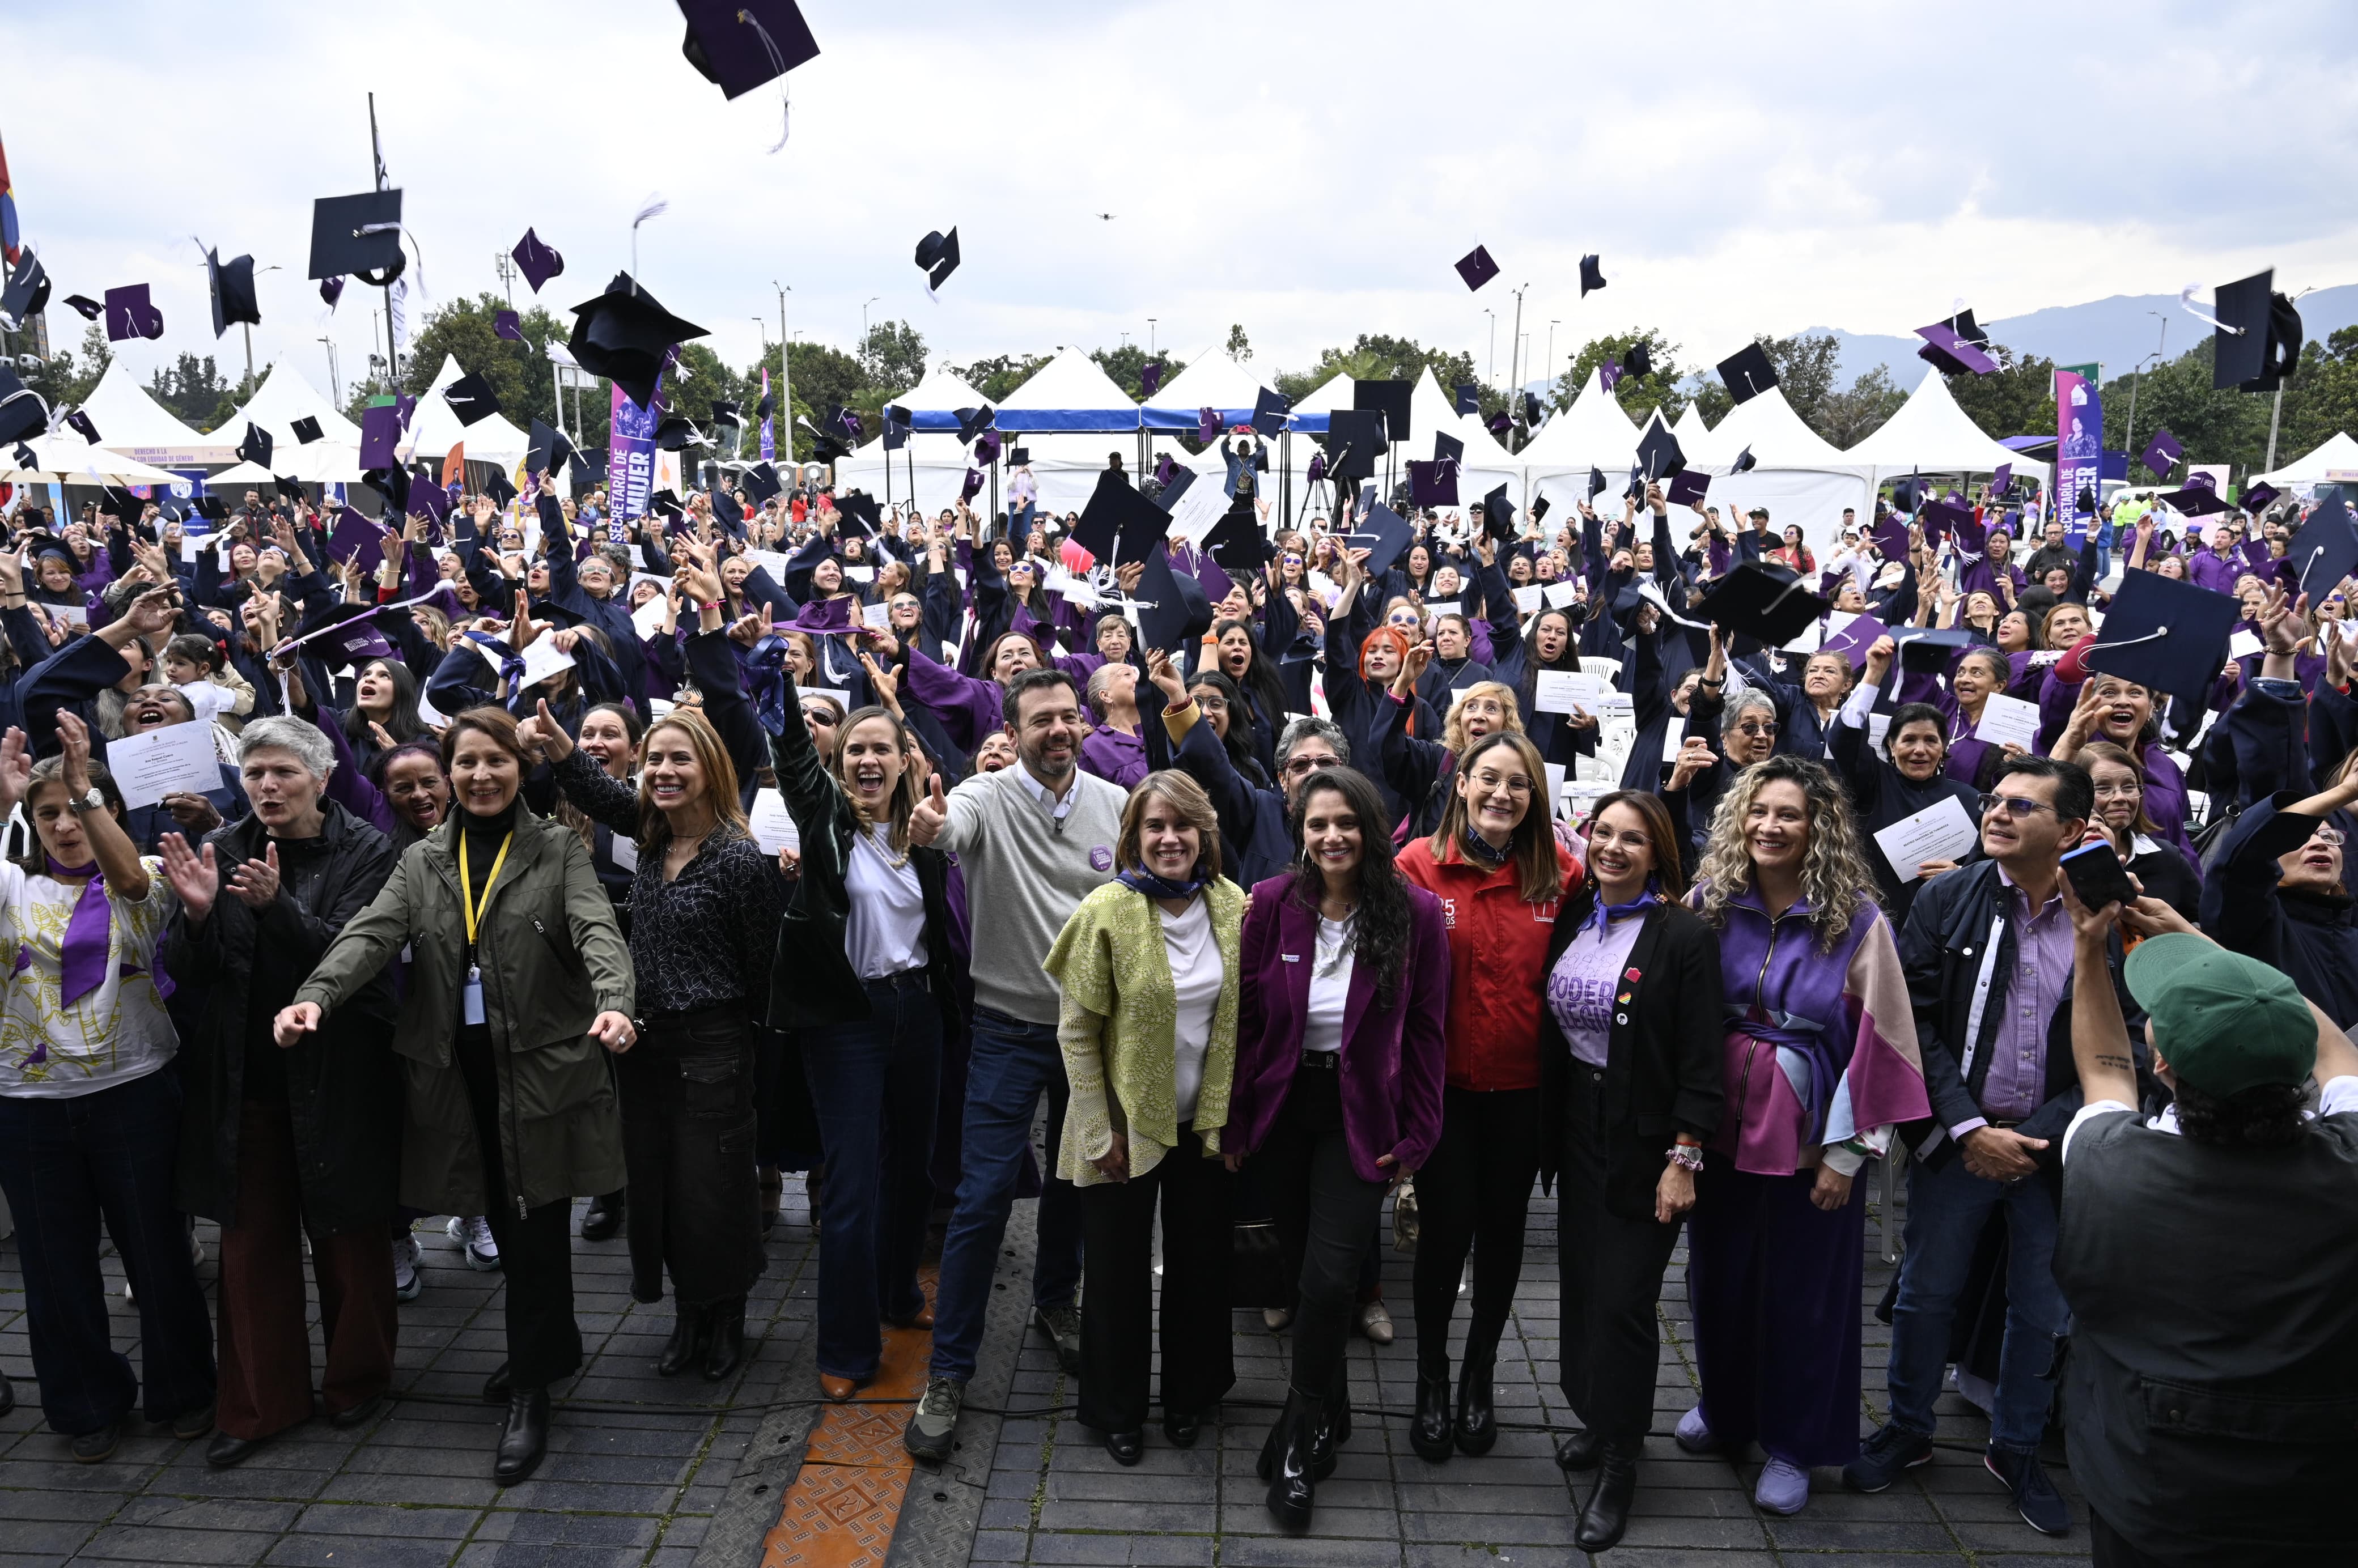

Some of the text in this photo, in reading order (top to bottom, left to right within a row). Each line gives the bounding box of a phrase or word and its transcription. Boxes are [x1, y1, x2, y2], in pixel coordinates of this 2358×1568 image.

[609, 448, 627, 543] SECRETARÍA DE
[626, 452, 650, 515] MUJER
[2059, 468, 2074, 534] SECRETARÍA DE
[1548, 972, 1615, 1008] PODER
